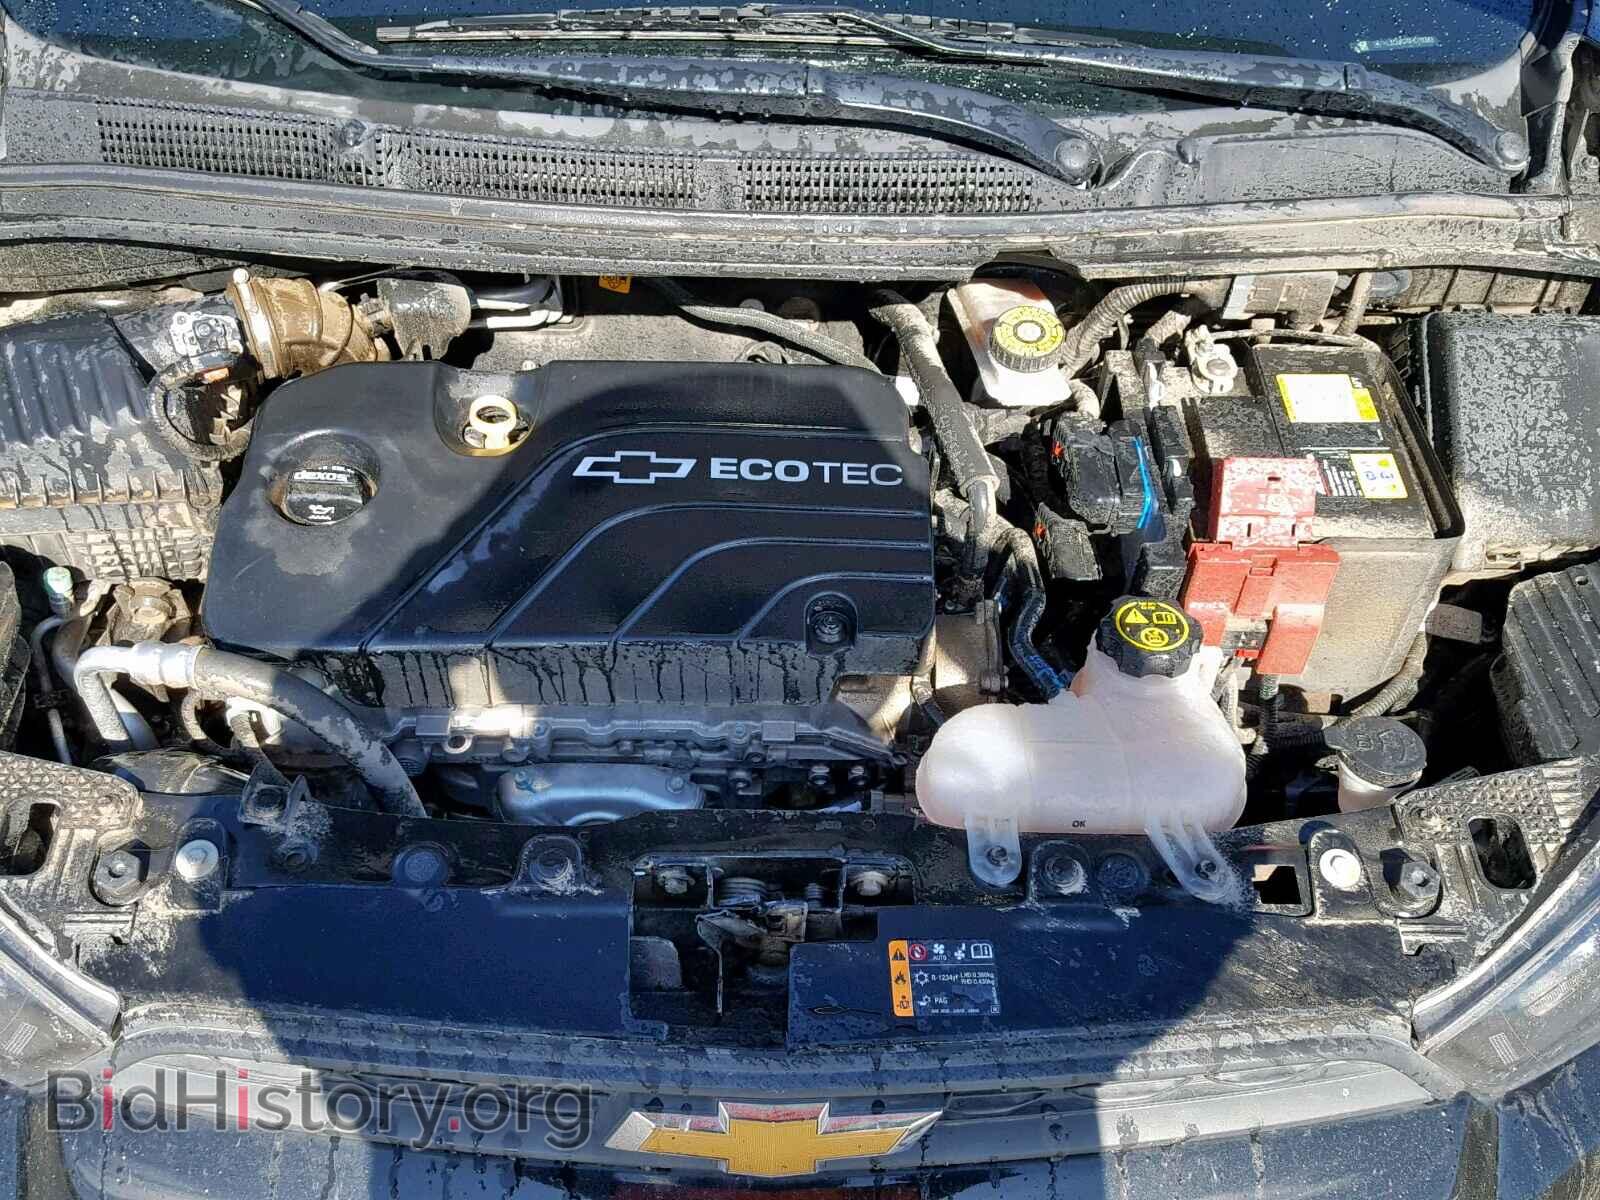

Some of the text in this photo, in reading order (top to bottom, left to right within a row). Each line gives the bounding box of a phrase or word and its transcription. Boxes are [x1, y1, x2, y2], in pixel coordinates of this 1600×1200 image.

[710, 457, 904, 486] ECOTEC
[1071, 820, 1087, 828] OK
[934, 996, 948, 1004] PAG
